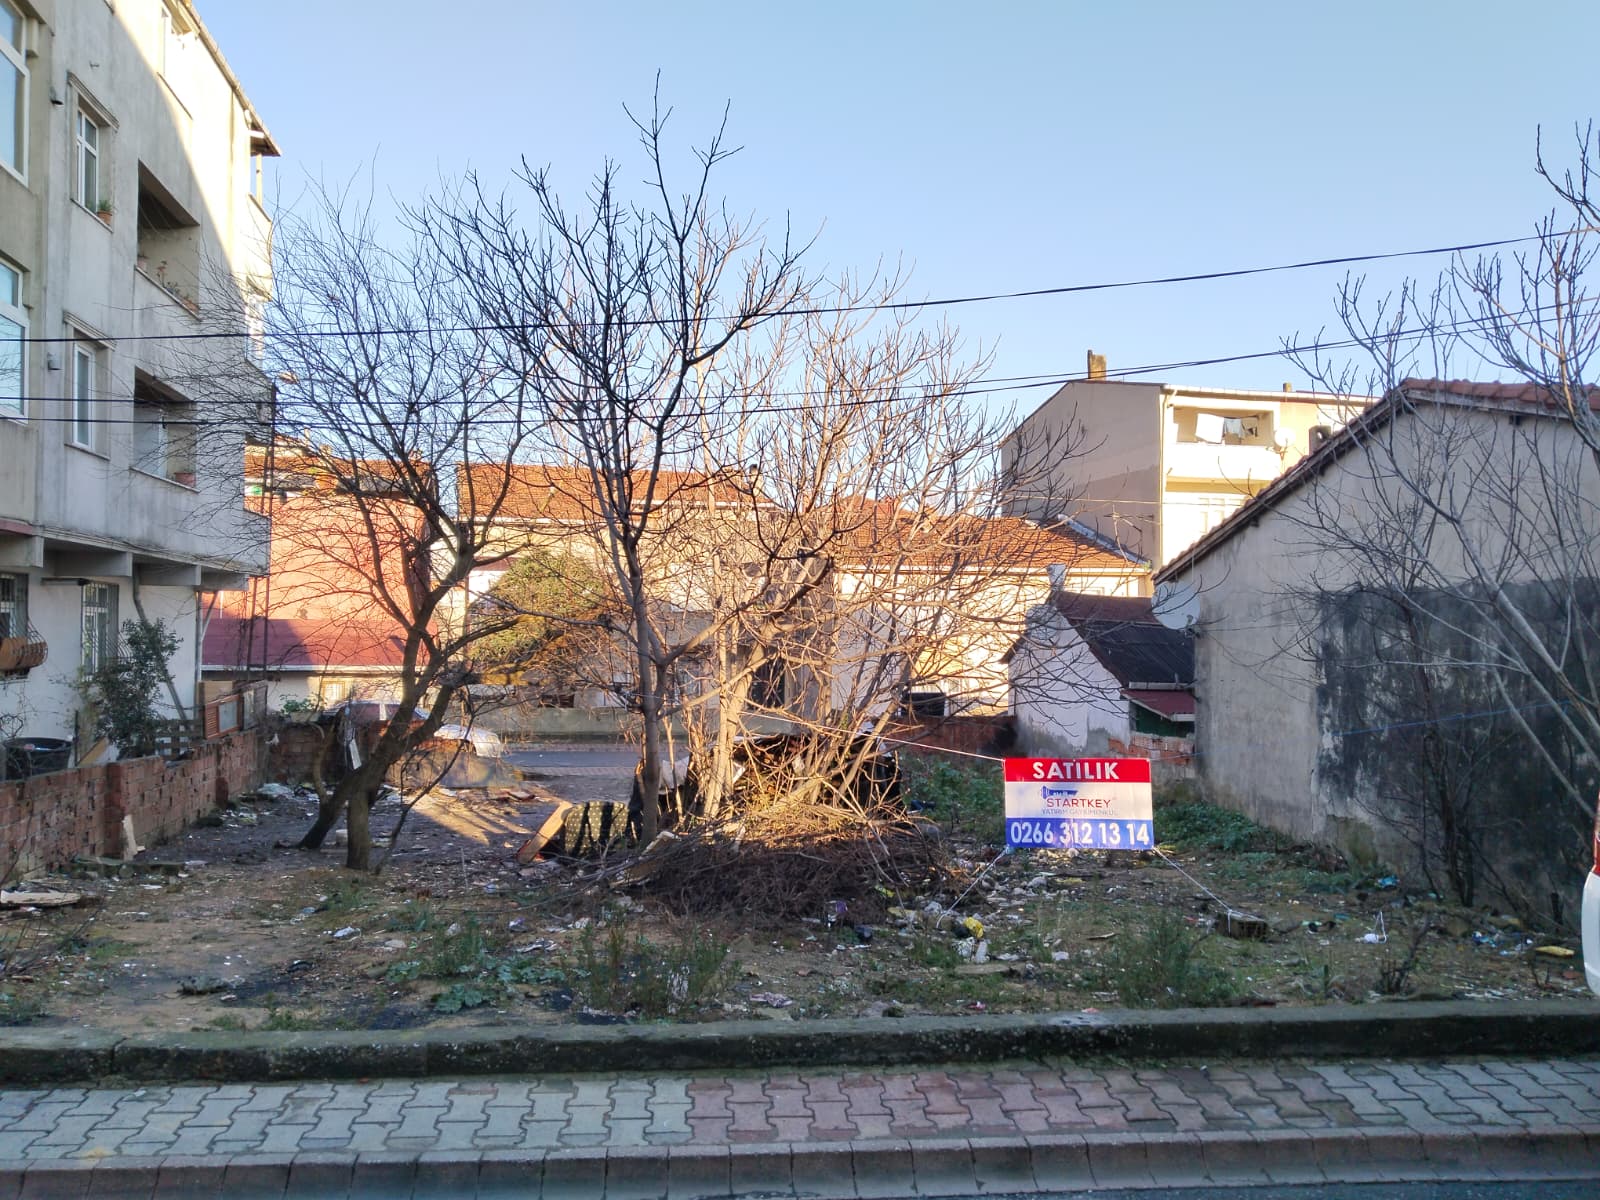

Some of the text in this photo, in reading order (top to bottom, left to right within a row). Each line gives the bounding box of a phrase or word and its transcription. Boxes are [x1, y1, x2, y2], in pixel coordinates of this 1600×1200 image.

[1032, 761, 1120, 780] SATILIK
[1046, 798, 1111, 808] STARTKEY
[1010, 821, 1149, 846] 0266 312 13 14
